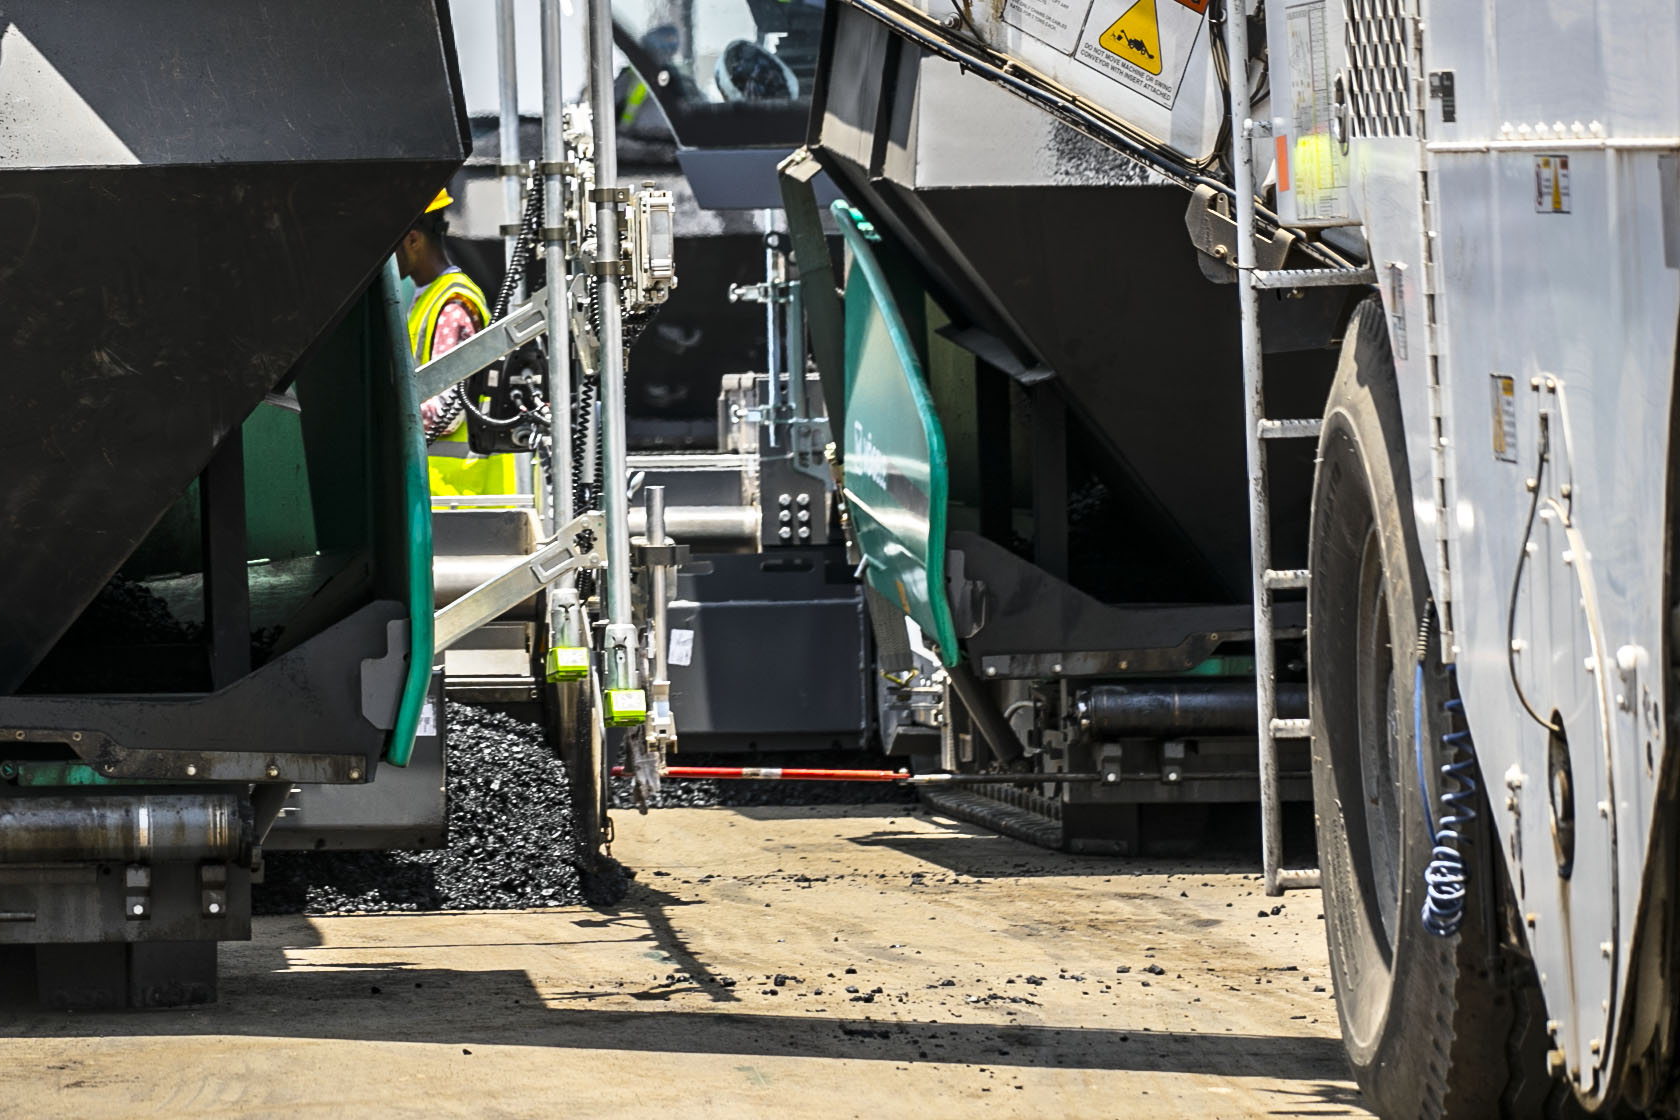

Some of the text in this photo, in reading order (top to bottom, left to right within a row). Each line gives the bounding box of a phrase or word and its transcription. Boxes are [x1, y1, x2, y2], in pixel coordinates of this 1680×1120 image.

[1080, 49, 1110, 69] CONVEYOR
[1110, 65, 1124, 76] WITH
[1124, 72, 1143, 86] INSERT
[1143, 82, 1171, 101] ATTACHED
[1084, 42, 1172, 93] DO NOT MOVE MACHINE OR SWING
